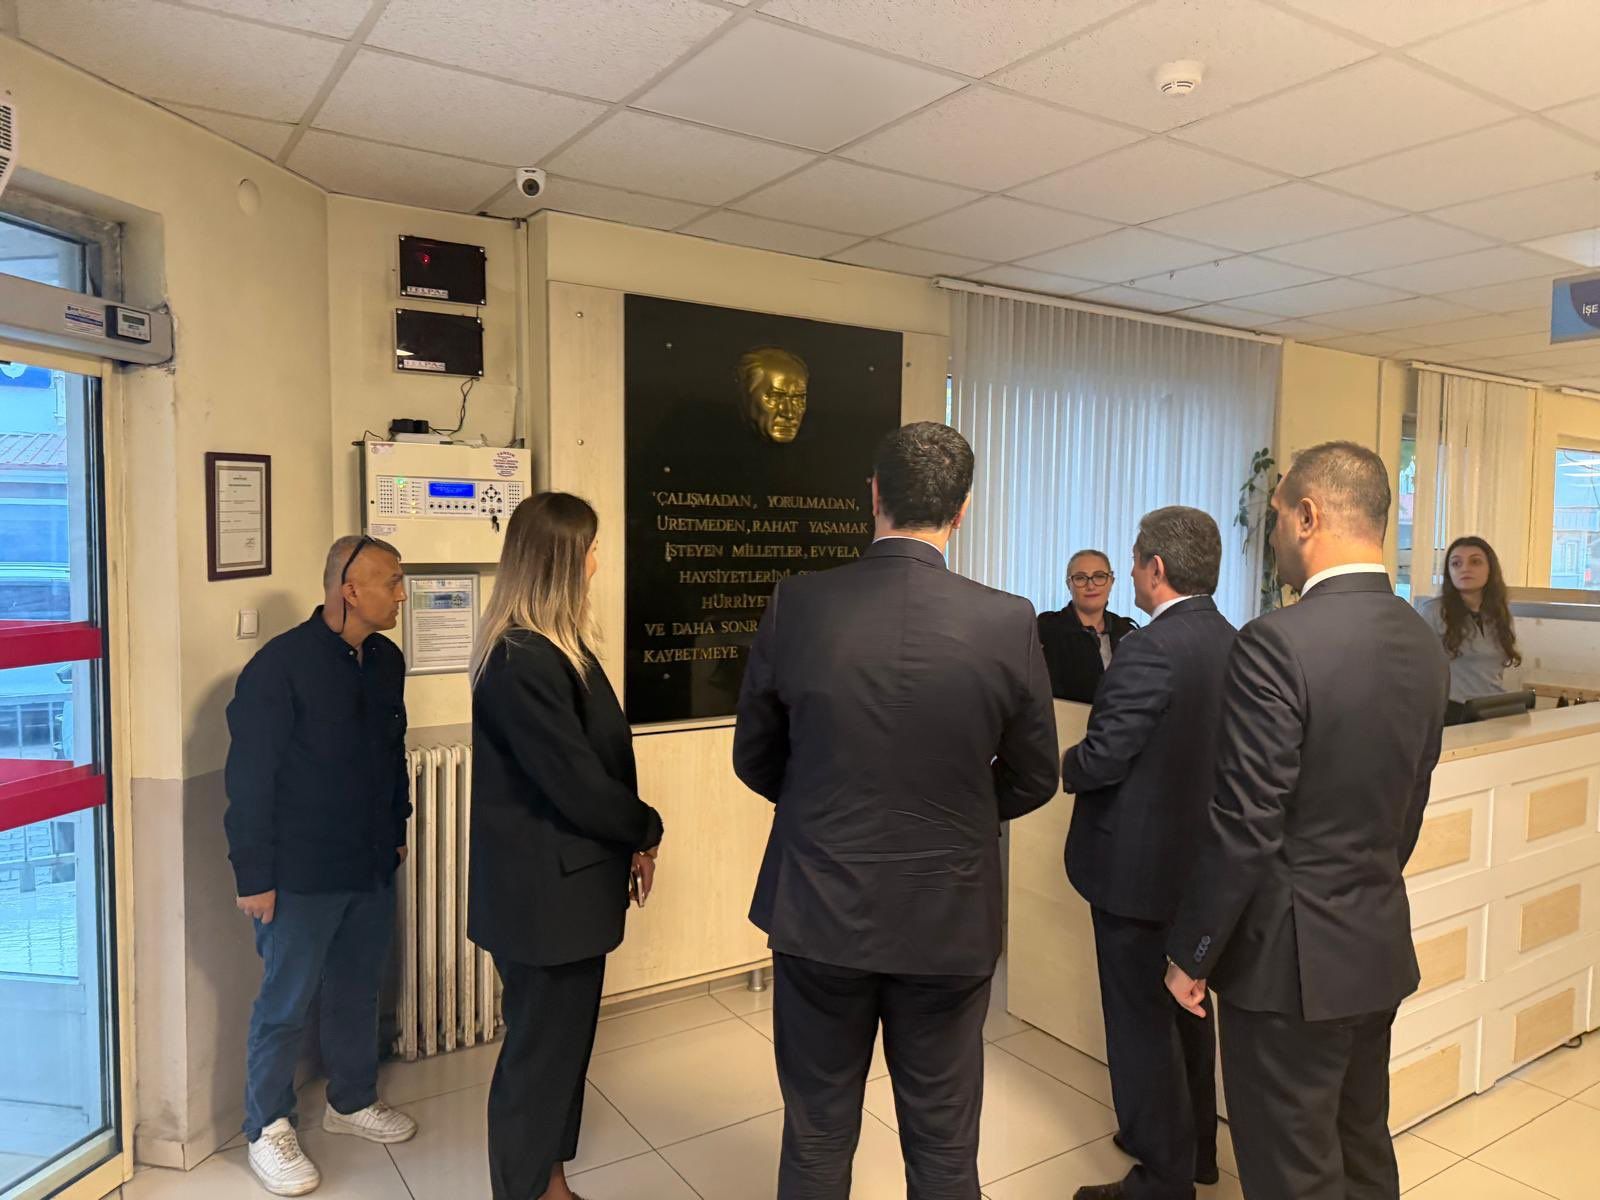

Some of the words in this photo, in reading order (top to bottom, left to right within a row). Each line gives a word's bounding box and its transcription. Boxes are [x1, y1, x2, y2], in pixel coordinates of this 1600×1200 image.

[1582, 303, 1599, 317] İŞE
[752, 520, 799, 533] RAHAT
[809, 521, 869, 535] YAŞAMAK
[666, 542, 724, 557] İSTEYEN
[811, 545, 860, 558] EVVELA
[644, 623, 666, 636] VE
[672, 622, 716, 635] DAHA
[721, 620, 759, 634] SONR
[643, 646, 739, 663] KAYBETMEYE
